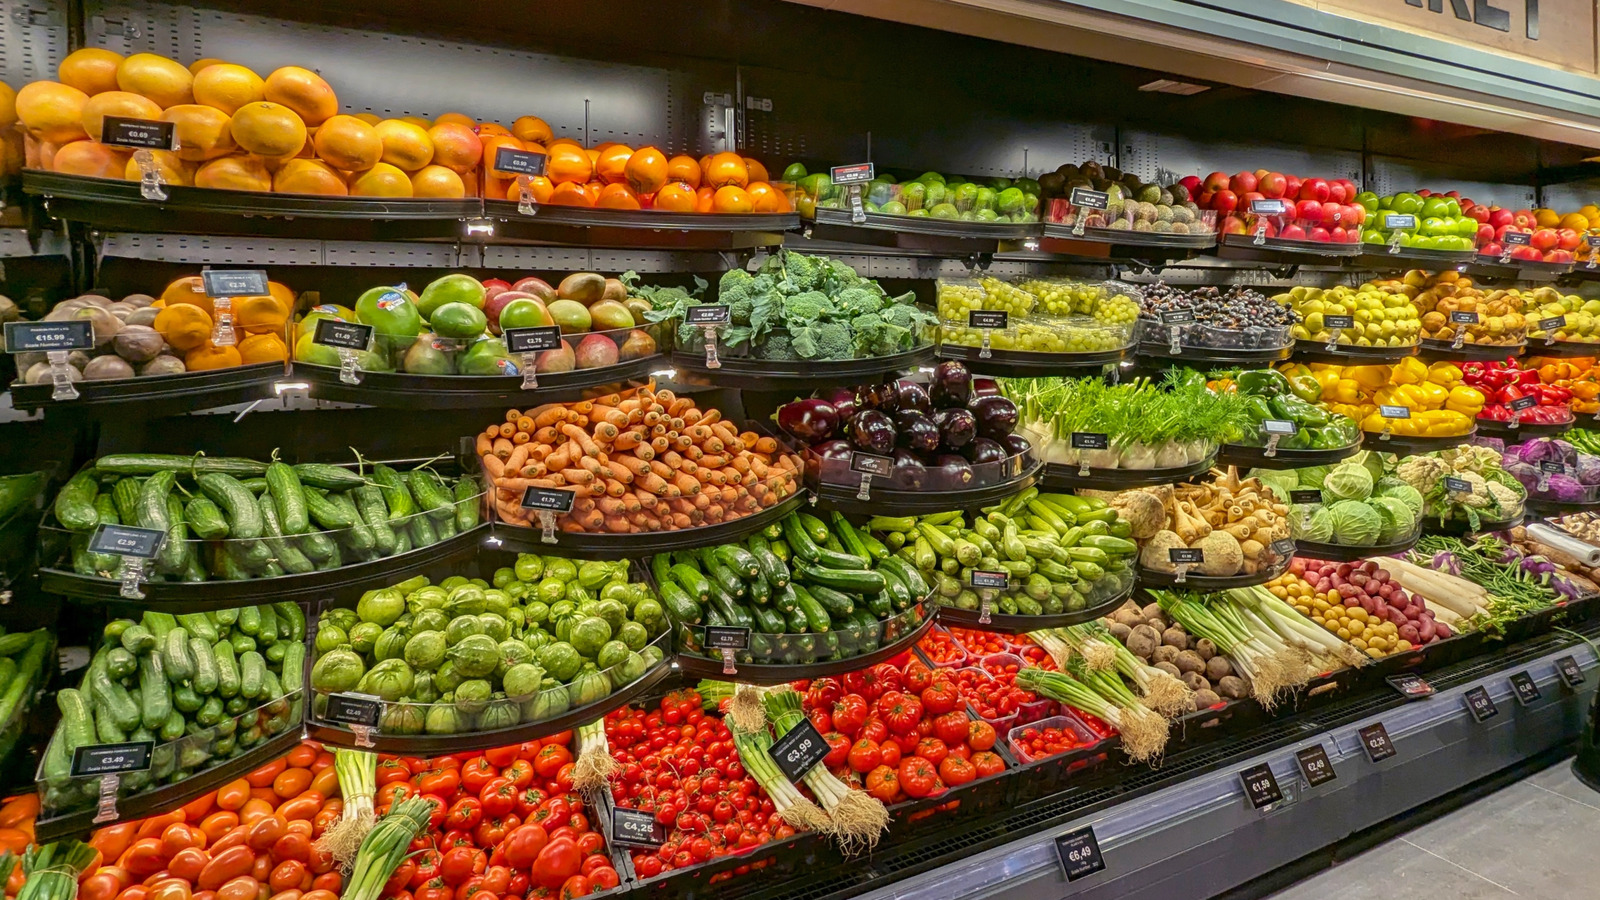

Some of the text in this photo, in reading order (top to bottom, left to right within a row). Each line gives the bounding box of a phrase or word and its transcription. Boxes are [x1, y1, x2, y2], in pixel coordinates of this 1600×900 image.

[117, 538, 136, 546] €2.99
[1370, 736, 1385, 748] €2,25
[787, 739, 812, 762] €3,99
[102, 756, 124, 764] €3.49
[1308, 760, 1324, 771] €2,49
[1252, 779, 1270, 792] €1,59
[624, 822, 654, 833] €4,25
[1069, 846, 1091, 862] €6,49
